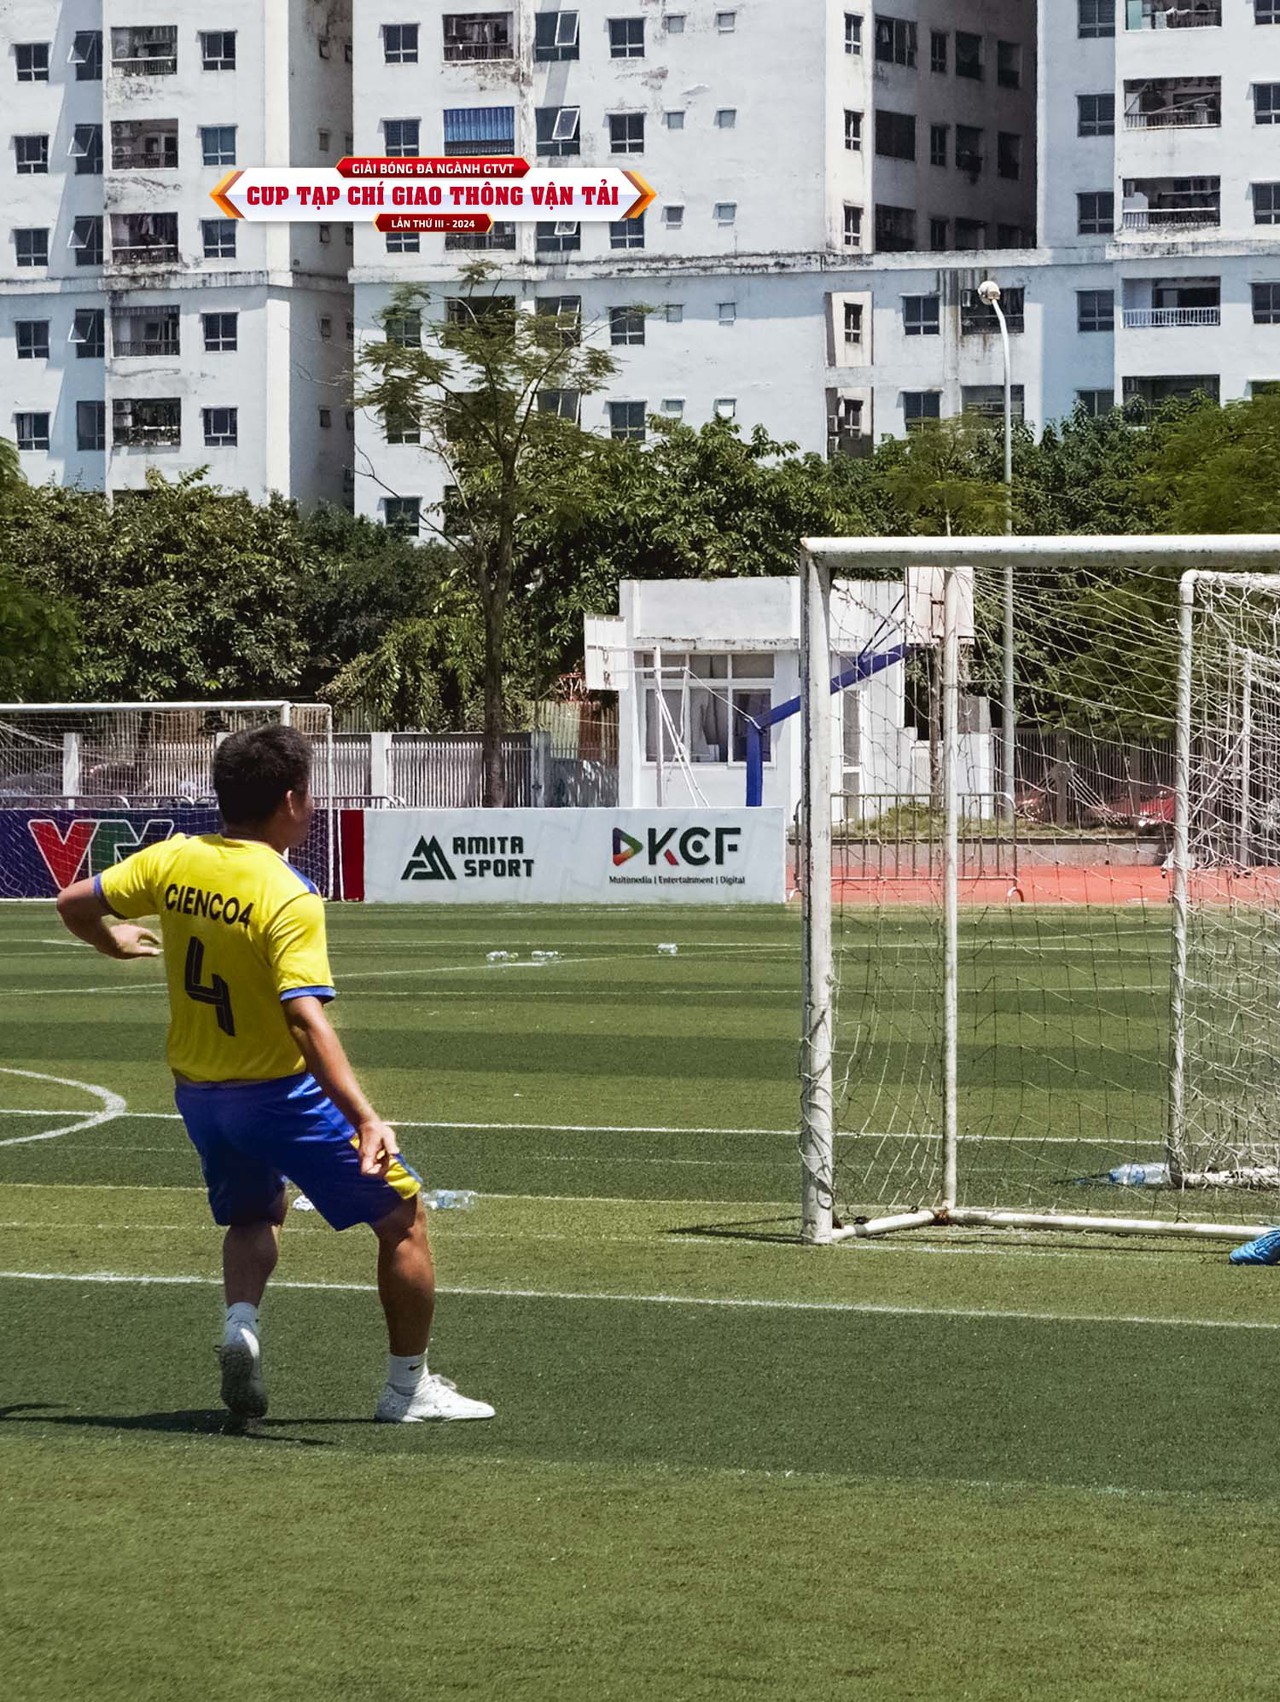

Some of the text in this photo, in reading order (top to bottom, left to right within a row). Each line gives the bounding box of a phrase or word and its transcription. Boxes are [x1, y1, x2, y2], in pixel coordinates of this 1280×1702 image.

[453, 836, 524, 854] AMITA
[648, 827, 741, 866] KCF
[464, 859, 534, 877] SPORT
[609, 875, 652, 884] Multimedia
[658, 875, 714, 884] Entertainment
[720, 875, 745, 886] Digital
[165, 883, 254, 929] CIENCO4
[184, 936, 235, 1037] 4
